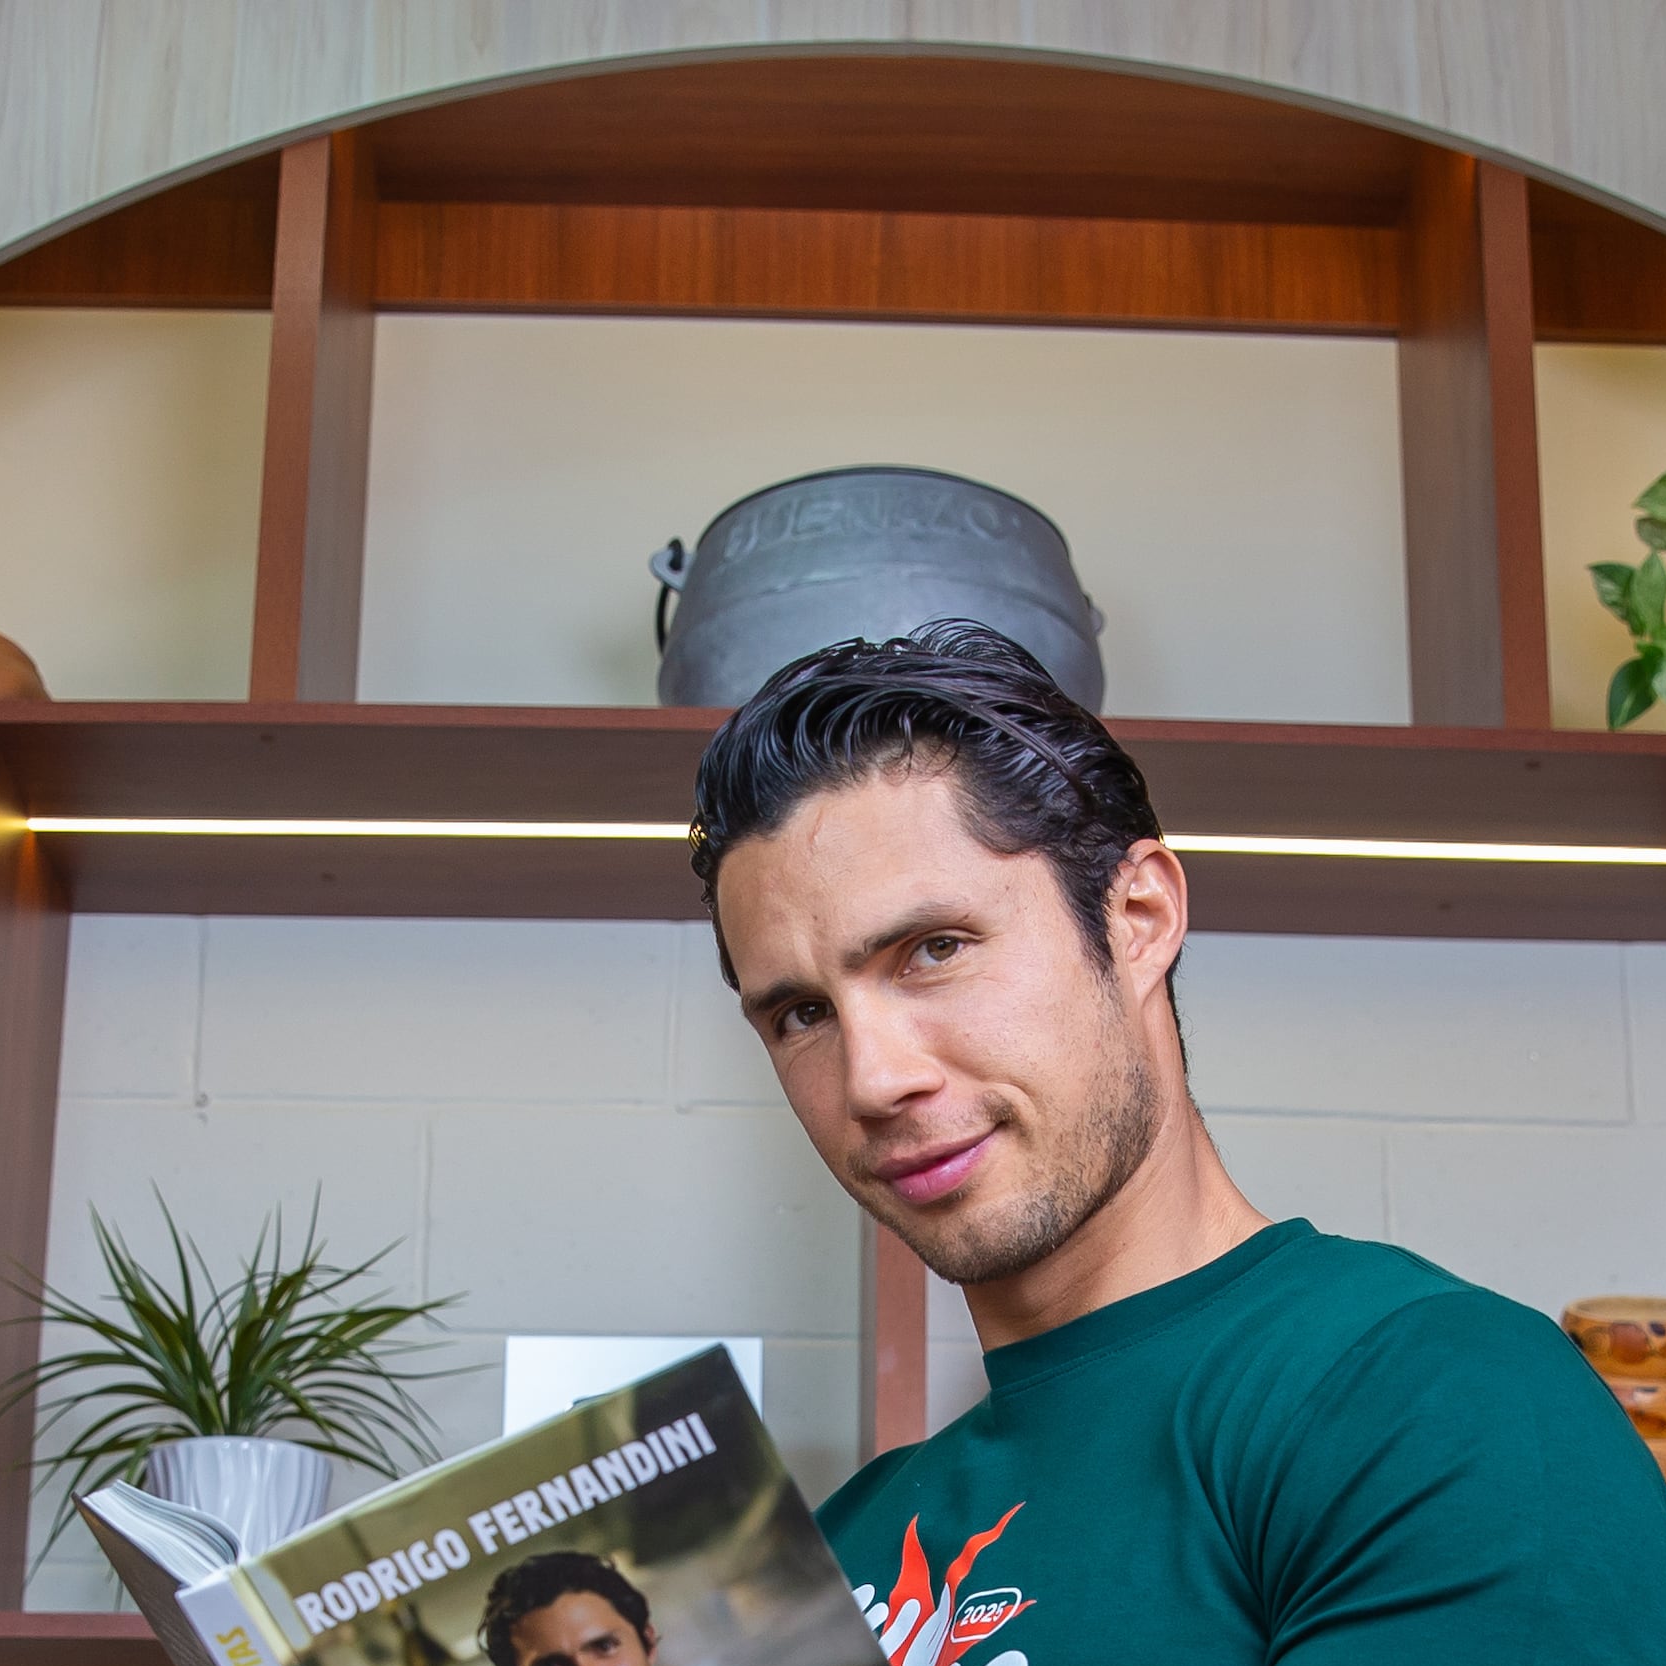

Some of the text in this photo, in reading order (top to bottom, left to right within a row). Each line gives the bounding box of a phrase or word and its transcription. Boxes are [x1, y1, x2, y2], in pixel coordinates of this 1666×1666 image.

[295, 1412, 718, 1636] RODRIGO FERNANDINI
[959, 1600, 1009, 1627] 2025
